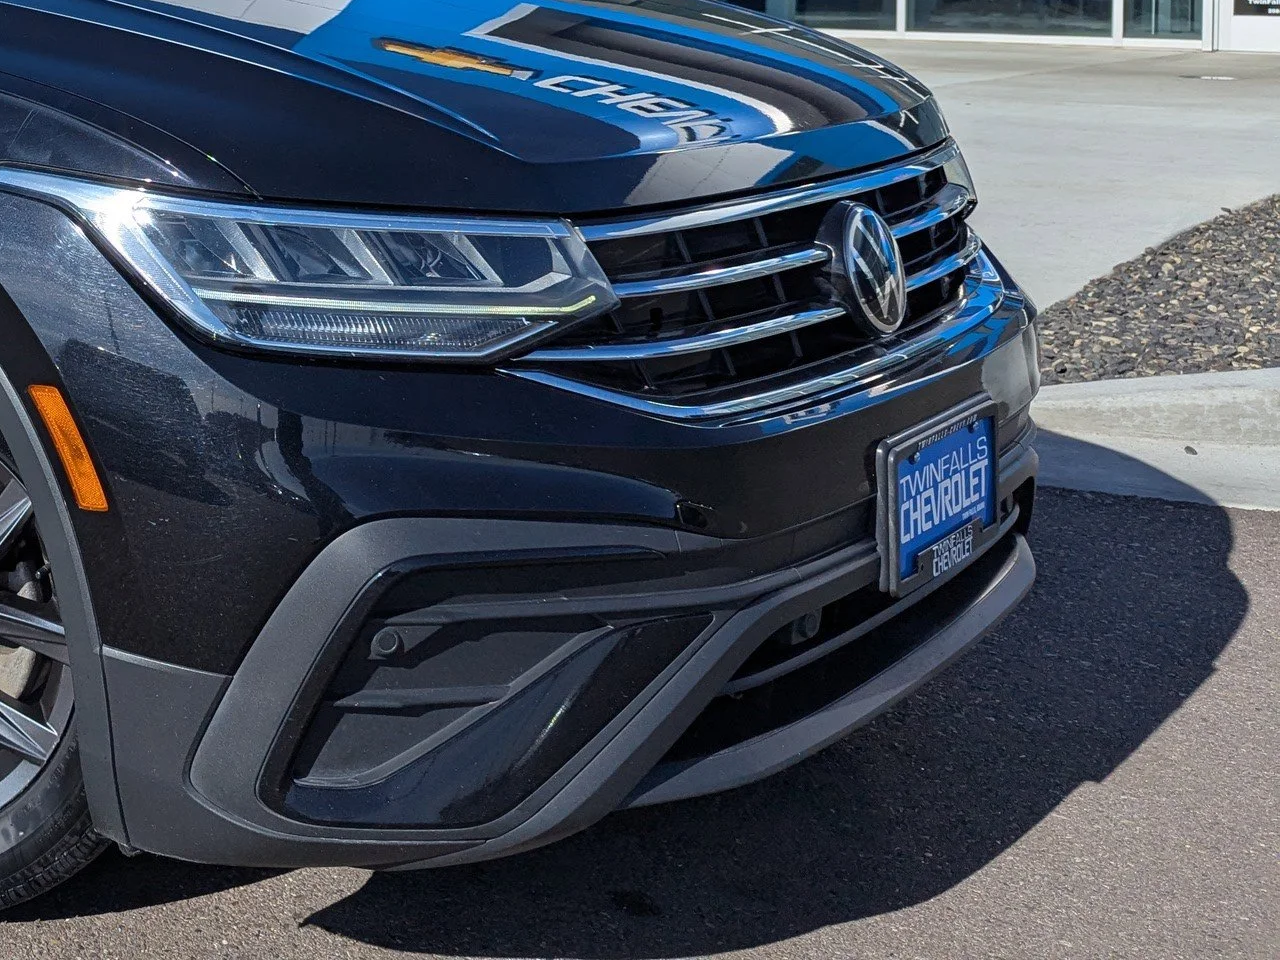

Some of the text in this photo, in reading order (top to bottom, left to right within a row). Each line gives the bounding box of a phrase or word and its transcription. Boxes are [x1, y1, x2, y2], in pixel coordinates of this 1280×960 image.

[900, 436, 988, 501] TWINFALLS
[900, 458, 988, 544] CHEVROLET
[932, 525, 973, 558] TWINFALLS
[932, 537, 973, 577] CHEVROLET
